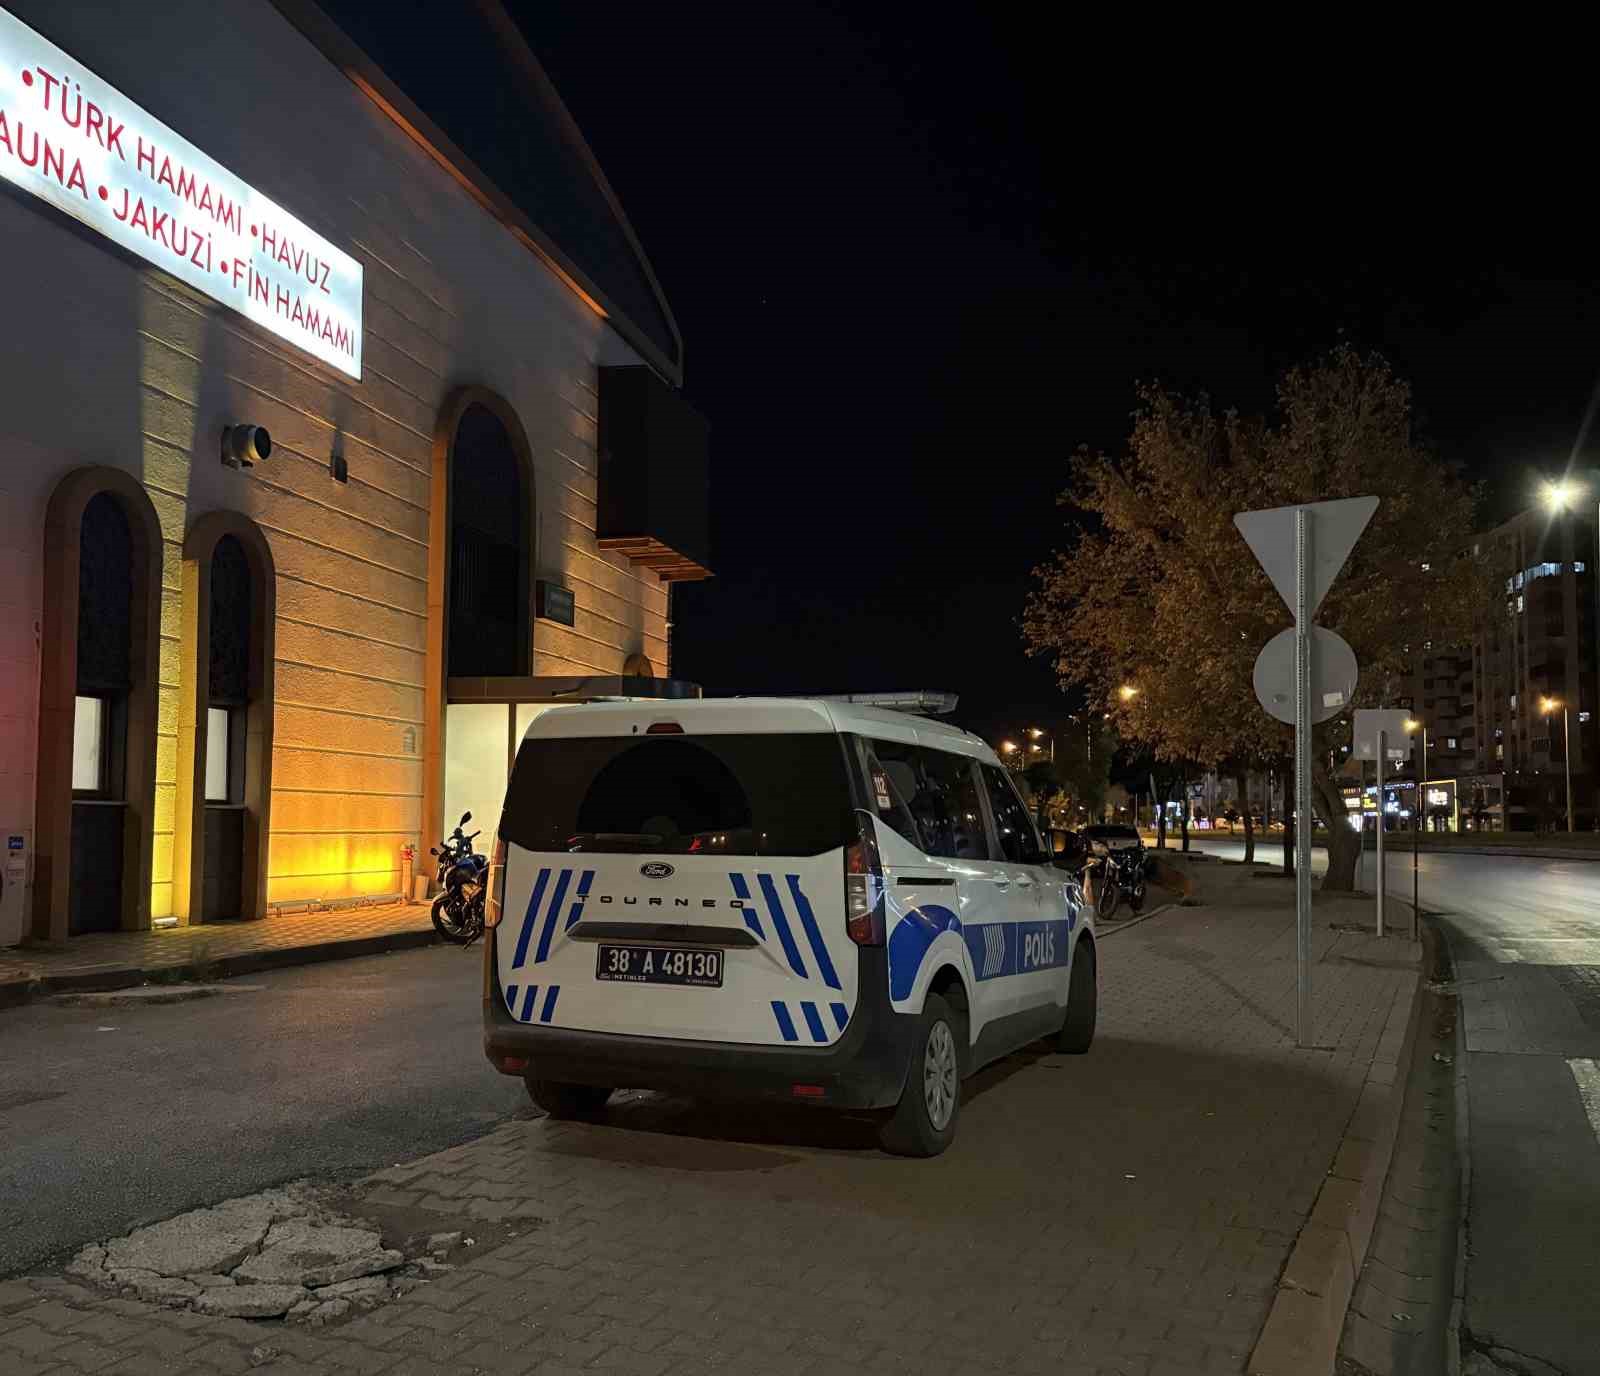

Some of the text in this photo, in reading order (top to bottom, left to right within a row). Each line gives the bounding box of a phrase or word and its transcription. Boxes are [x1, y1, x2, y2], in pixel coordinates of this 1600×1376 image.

[36, 66, 243, 236] TÜRK HAMAMI
[113, 188, 212, 272] JAKUZİ
[262, 223, 331, 294] HAVUZ
[233, 258, 355, 358] FİN HAMAMI
[578, 895, 744, 908] TOURNEO
[608, 949, 718, 977] 38 A 48130
[1024, 923, 1055, 968] POLİS
